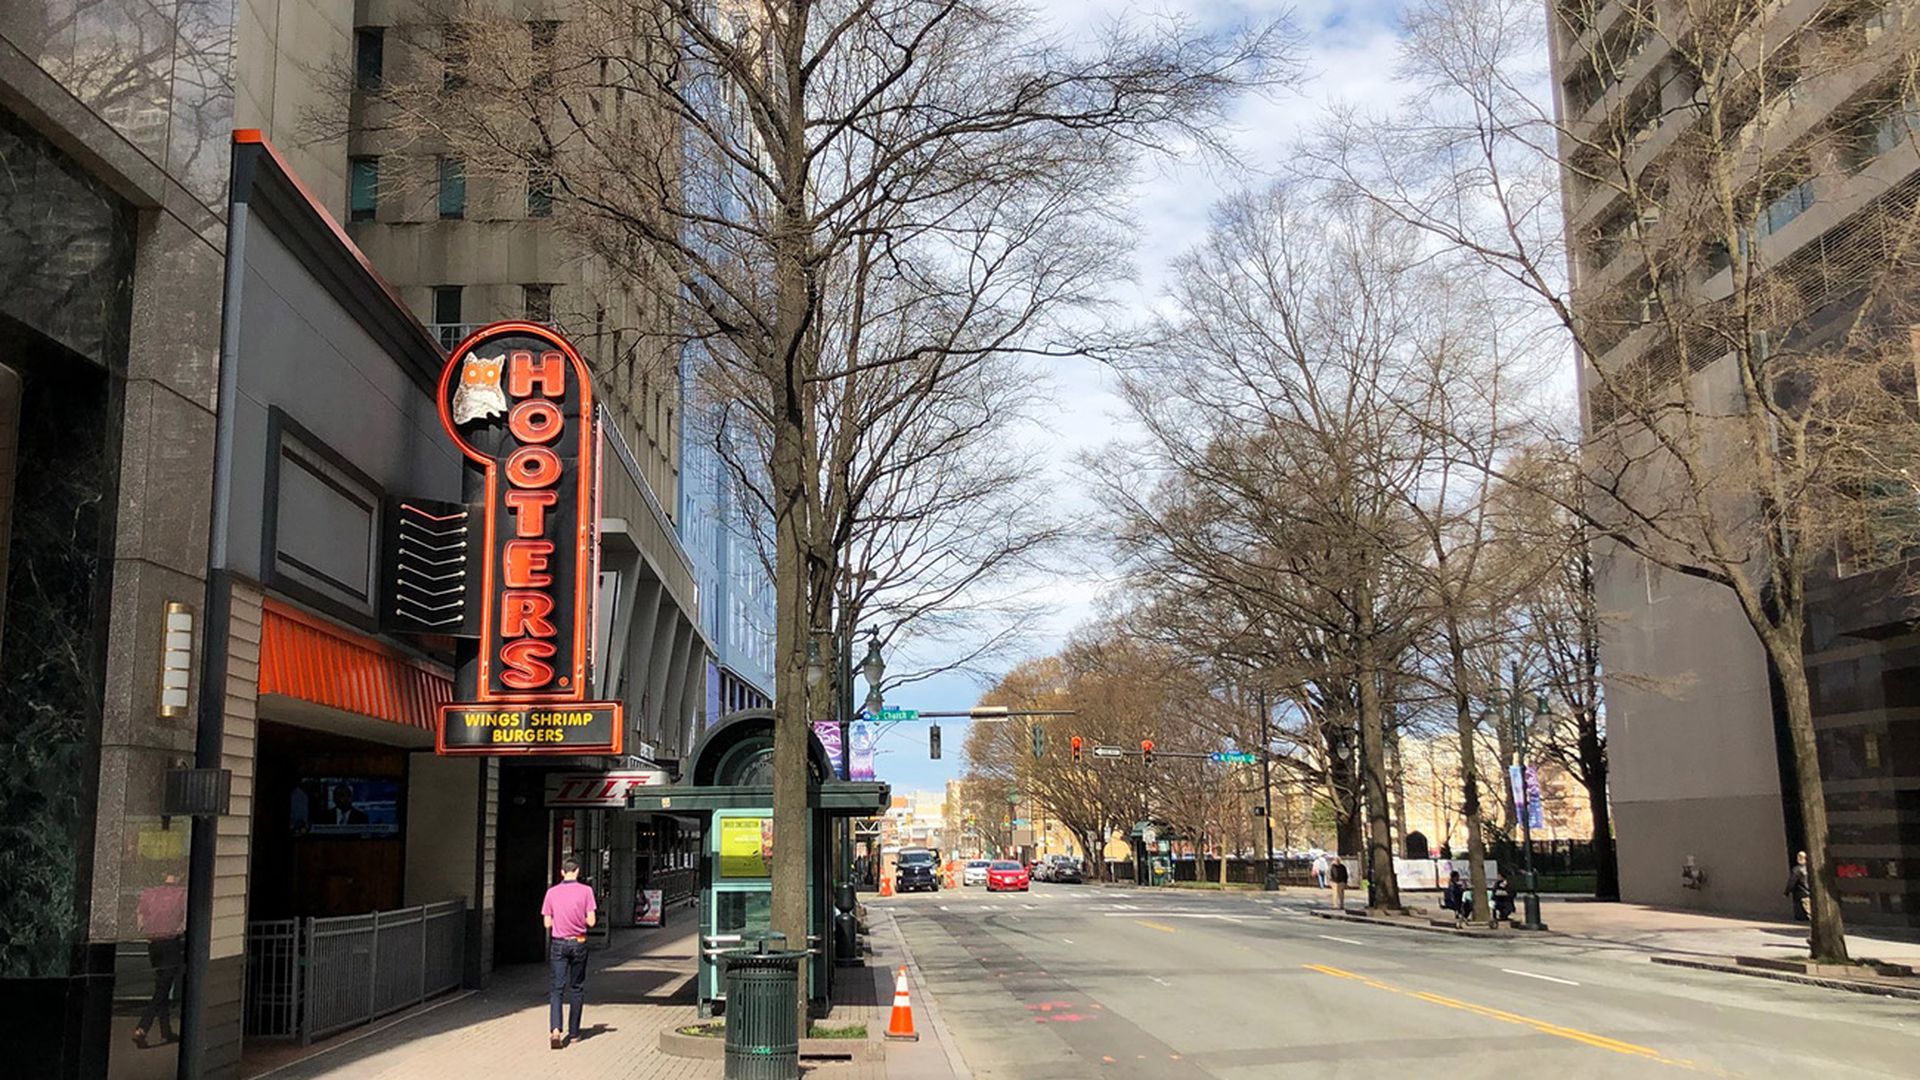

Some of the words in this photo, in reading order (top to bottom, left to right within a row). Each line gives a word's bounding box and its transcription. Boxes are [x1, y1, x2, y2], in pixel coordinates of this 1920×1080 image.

[499, 350, 565, 689] HOOTERS
[464, 713, 520, 727] WINGS
[530, 712, 594, 727] SHRIMP
[492, 728, 564, 743] BURGERS
[556, 780, 647, 799] TILT
